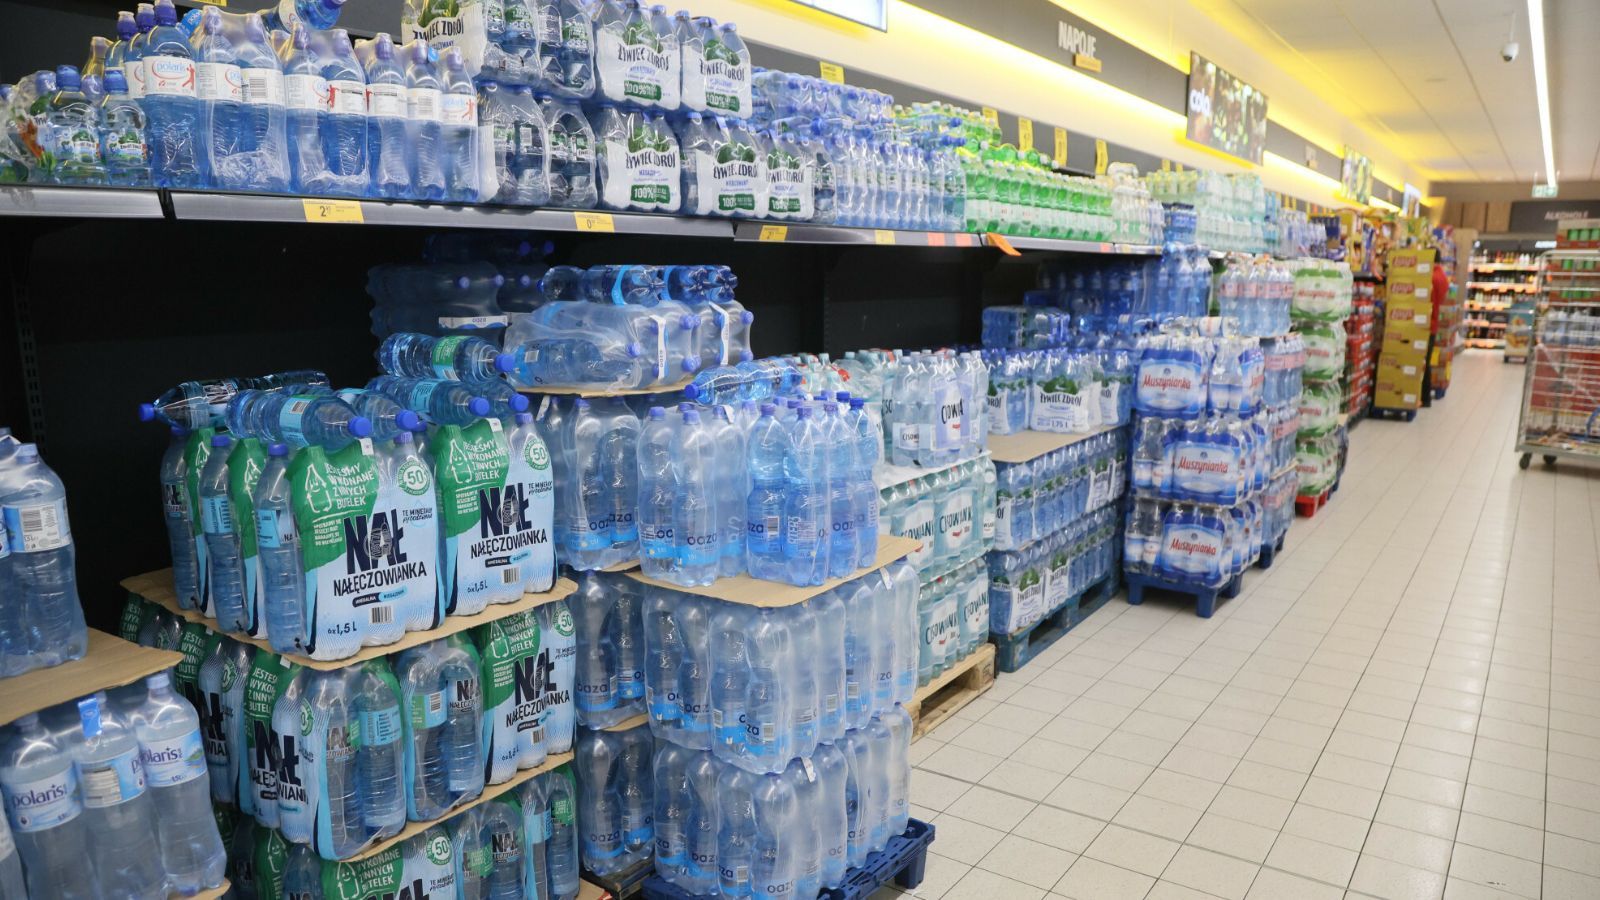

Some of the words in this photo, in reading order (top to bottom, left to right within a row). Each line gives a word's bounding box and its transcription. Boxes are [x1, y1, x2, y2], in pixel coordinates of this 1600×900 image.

[1058, 20, 1097, 58] NAPOJE
[1143, 374, 1191, 391] Muszynianka
[532, 447, 547, 462] 50
[1177, 456, 1229, 474] Muszynianka
[406, 469, 425, 485] 50
[479, 482, 533, 539] NAŁ
[343, 508, 408, 575] NAŁ
[470, 528, 548, 560] NAŁĘCZOWIANKA
[1169, 537, 1217, 556] Muszynianka
[333, 561, 428, 597] NAŁĘCZOWIANKA
[561, 614, 573, 628] 50
[12, 783, 65, 809] polaris
[434, 841, 449, 857] 50
